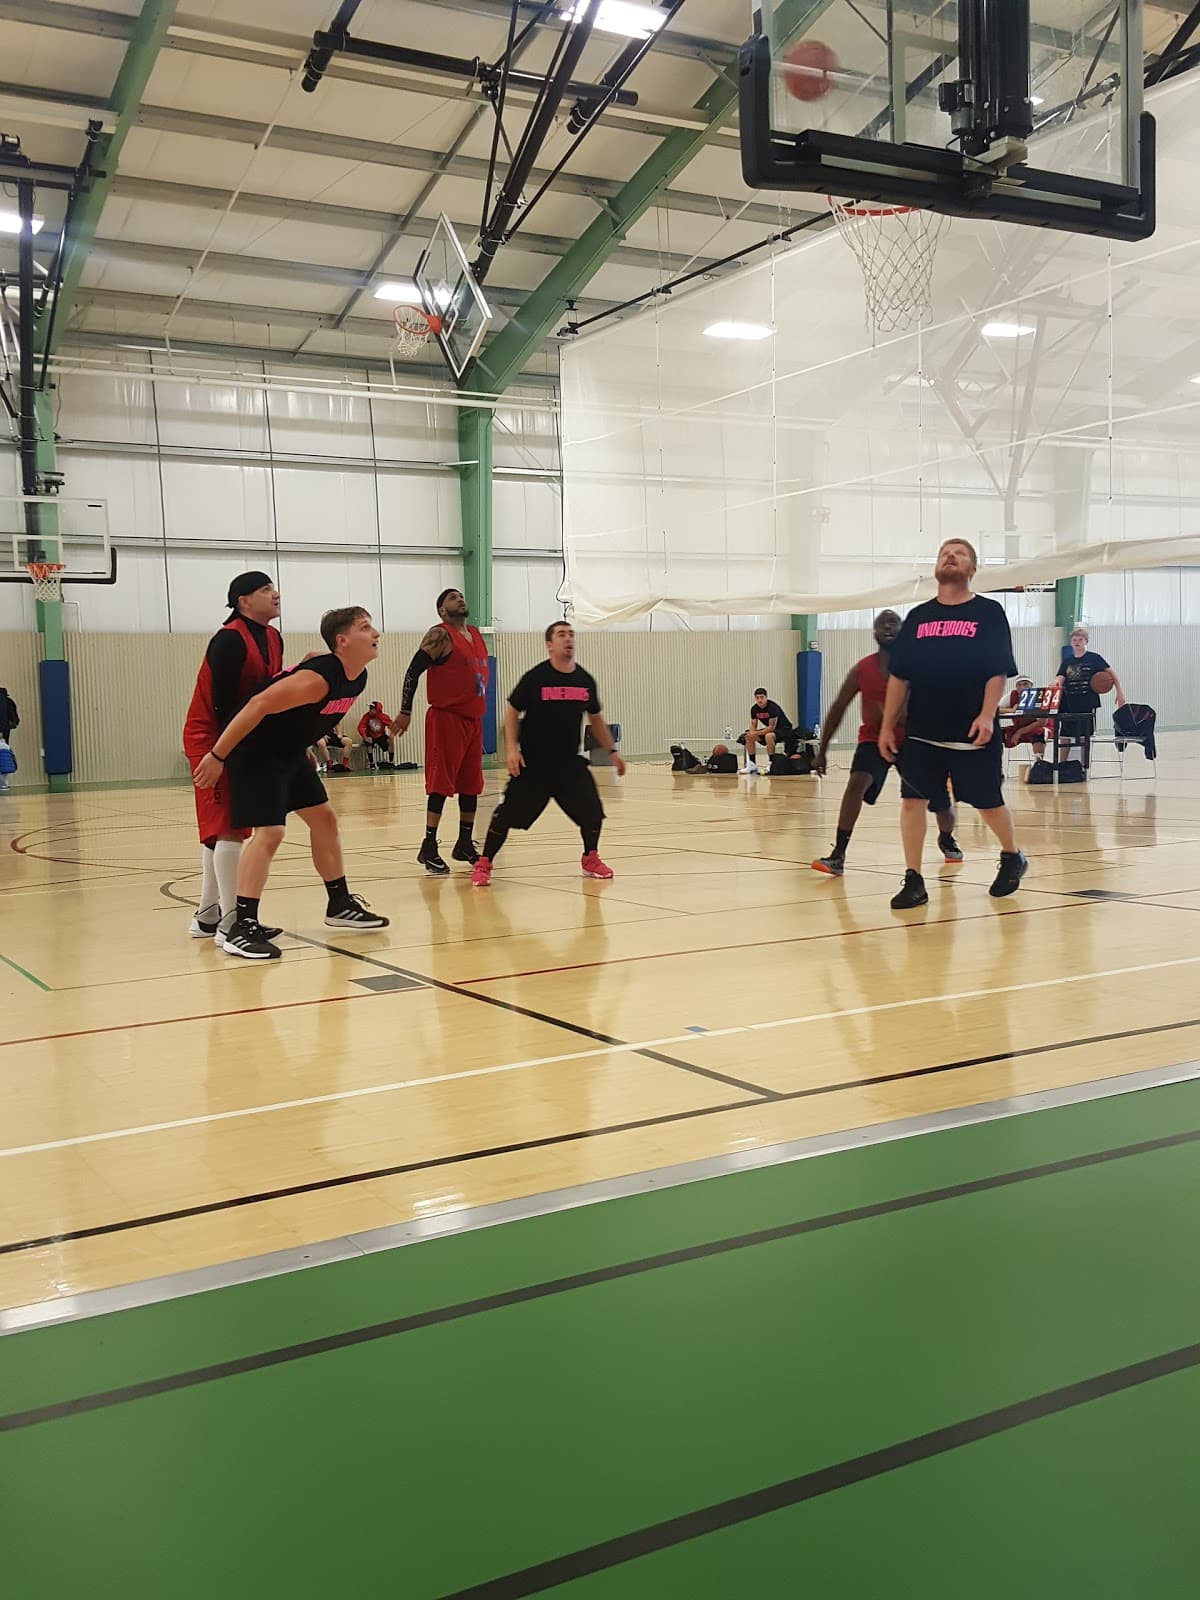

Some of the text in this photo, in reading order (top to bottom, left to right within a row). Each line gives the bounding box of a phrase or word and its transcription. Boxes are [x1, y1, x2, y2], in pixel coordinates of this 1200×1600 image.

[917, 620, 979, 639] UNDERDOGS
[1018, 690, 1037, 707] 27
[1042, 690, 1061, 707] 34
